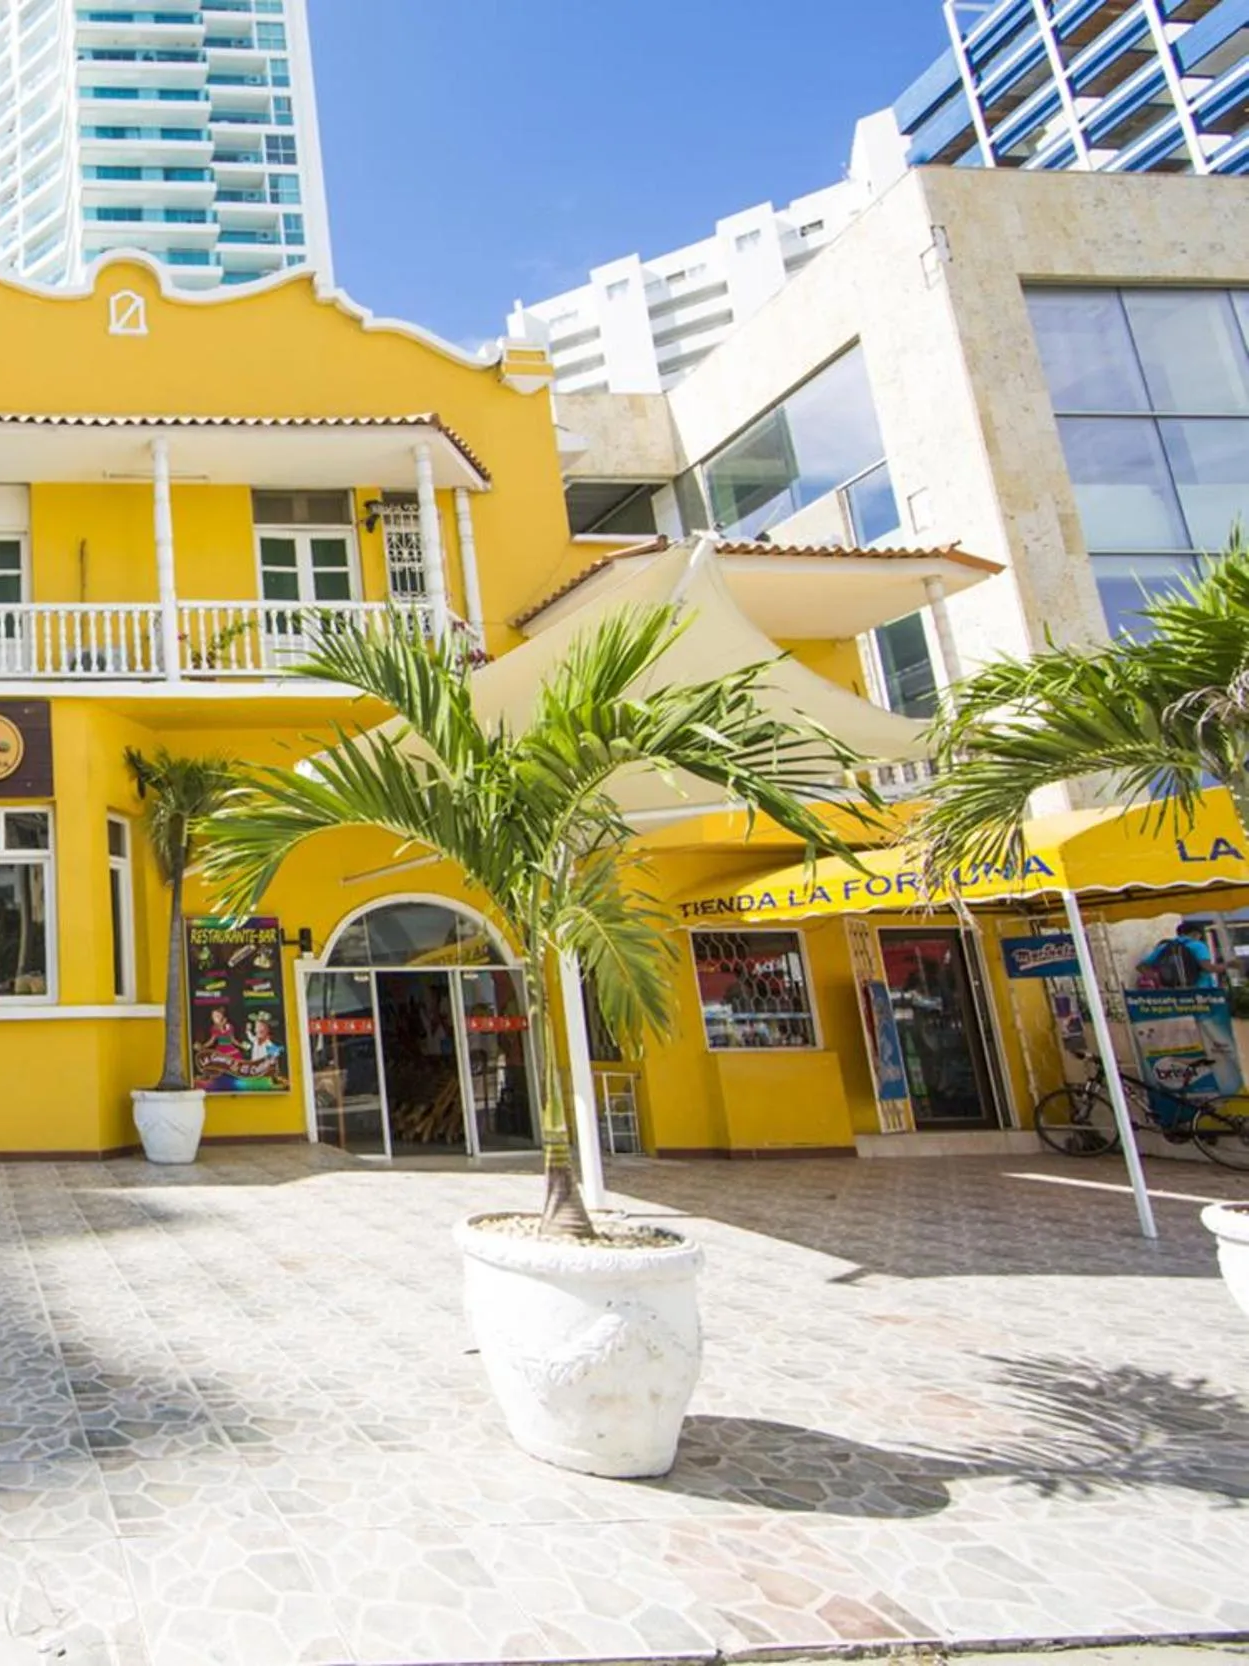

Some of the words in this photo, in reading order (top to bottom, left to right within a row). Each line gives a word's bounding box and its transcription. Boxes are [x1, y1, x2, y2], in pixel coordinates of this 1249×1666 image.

[1175, 837, 1245, 862] LA
[679, 892, 777, 918] TIENDA
[788, 886, 831, 907] LA
[843, 855, 1054, 900] FORUNA
